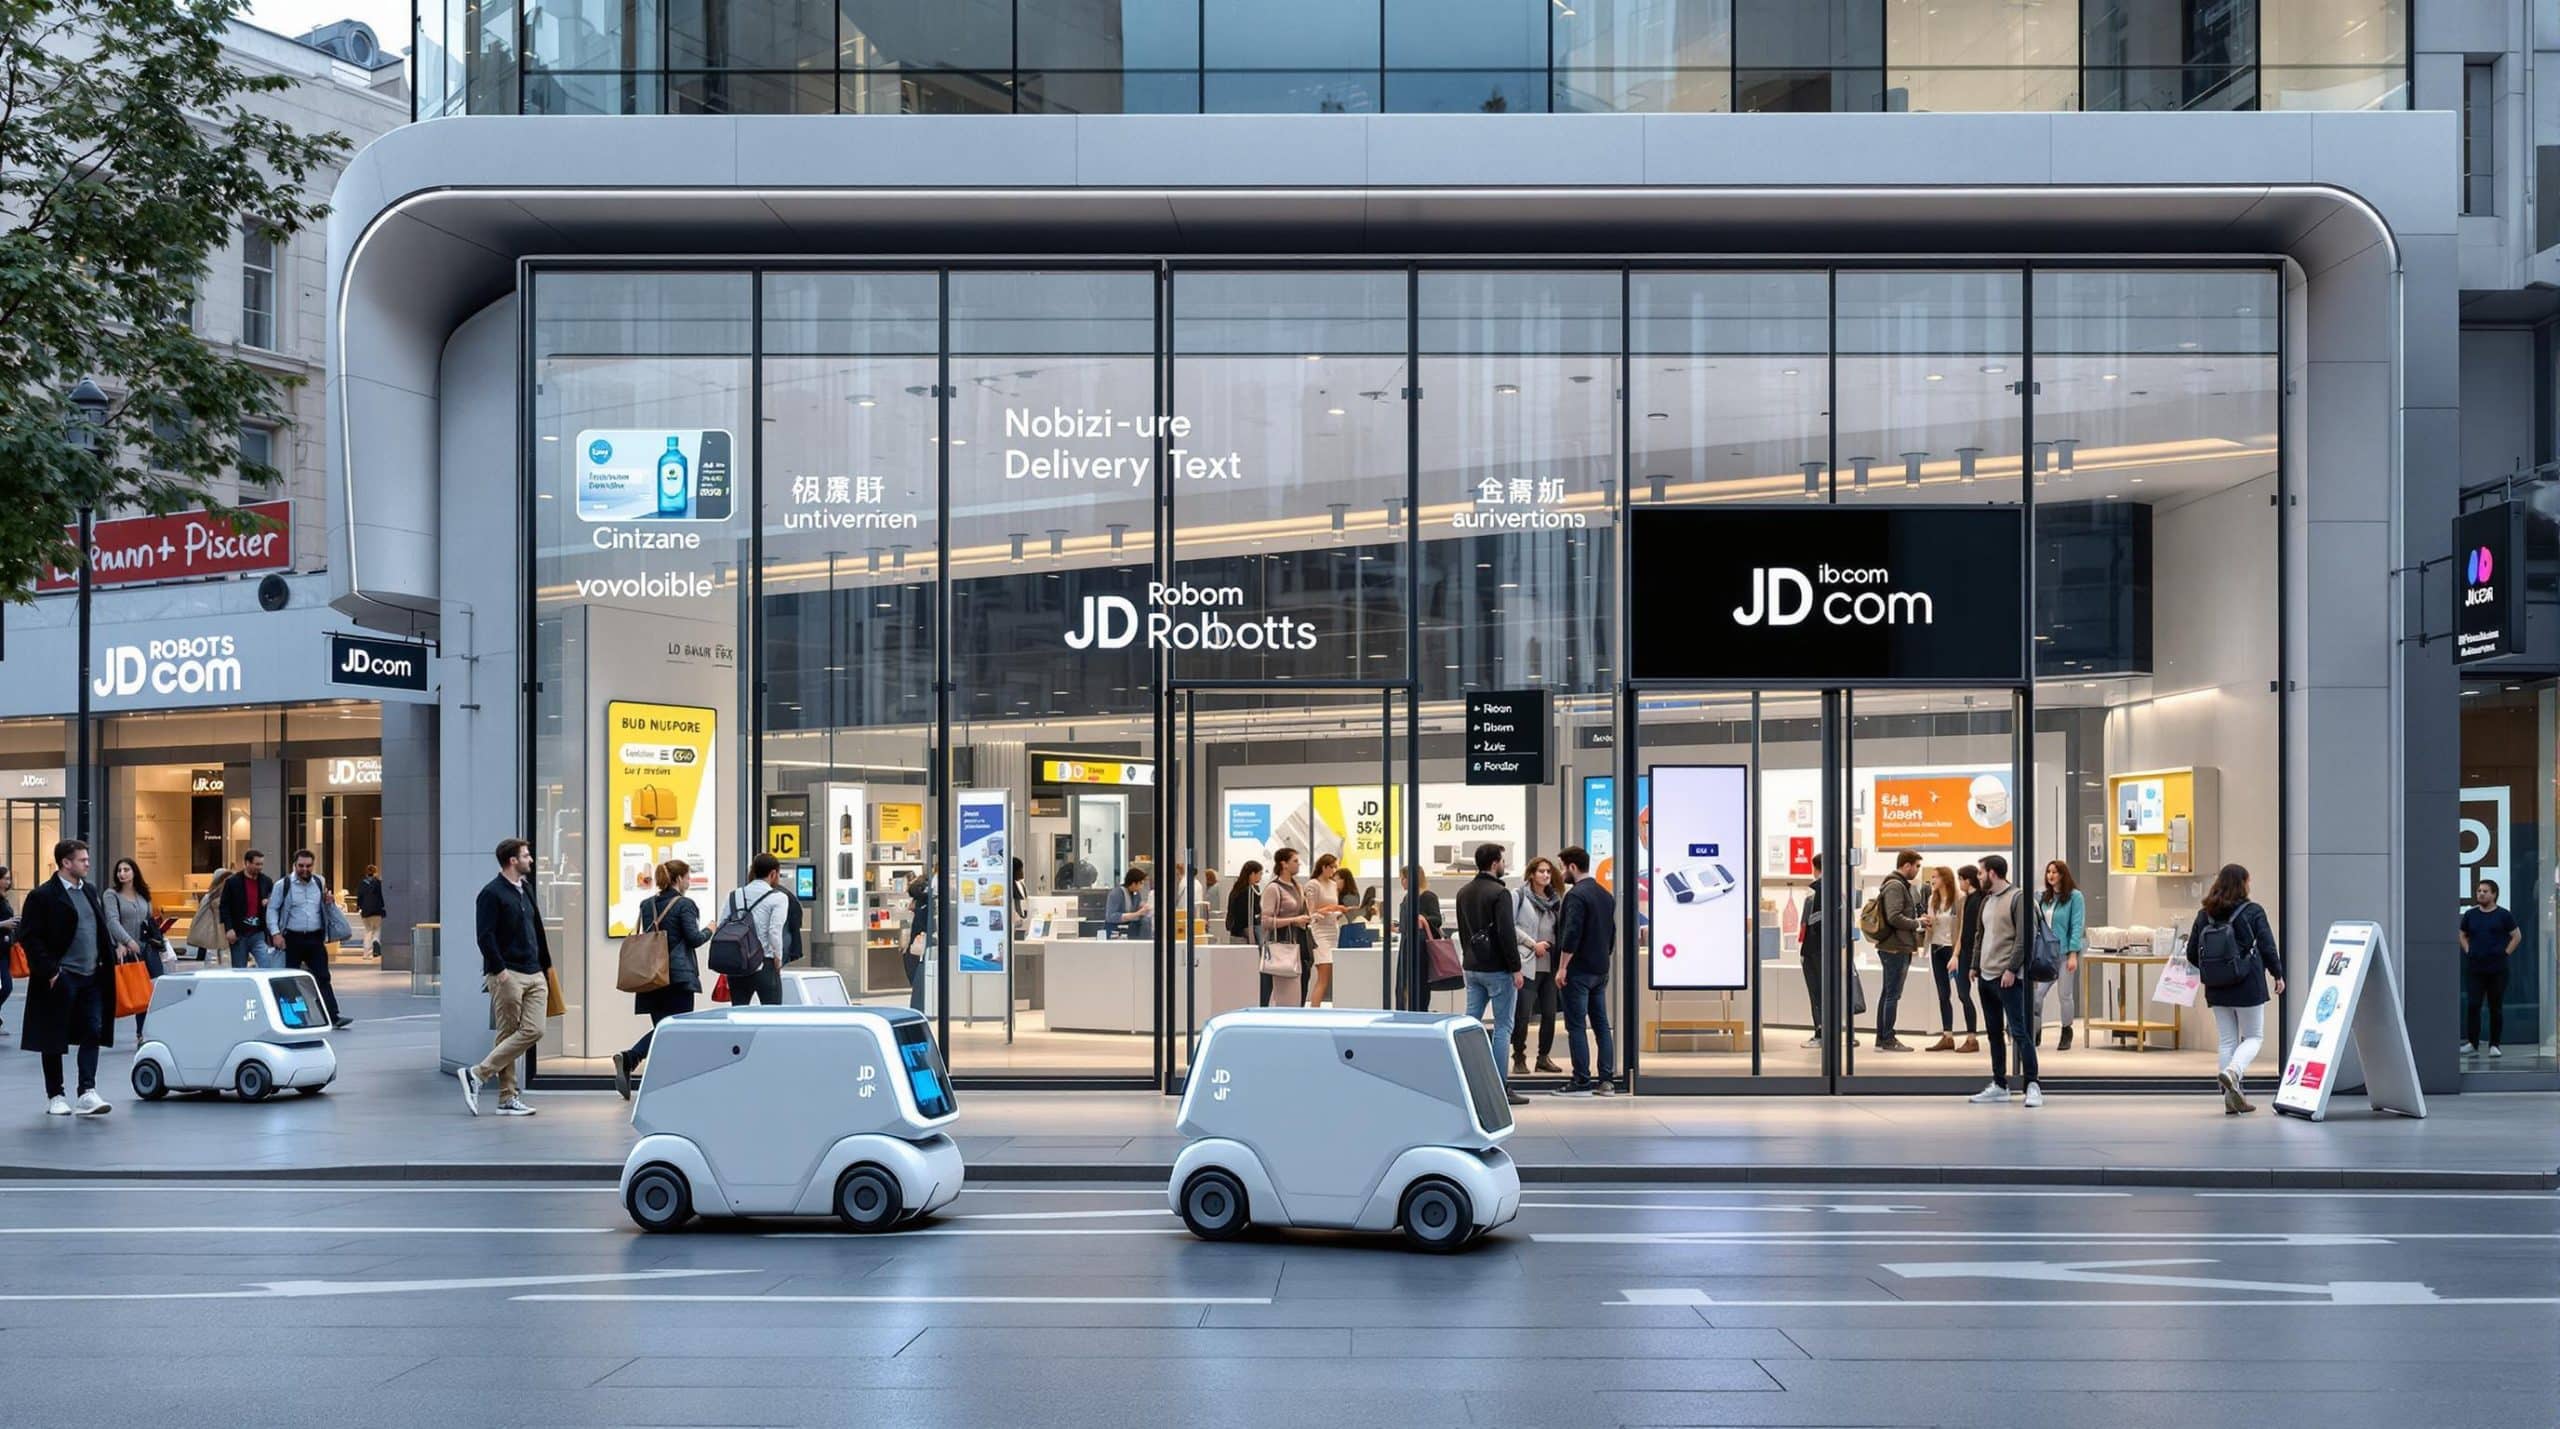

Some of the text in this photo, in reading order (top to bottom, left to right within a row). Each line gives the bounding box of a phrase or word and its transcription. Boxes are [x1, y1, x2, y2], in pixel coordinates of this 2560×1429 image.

[1005, 406, 1192, 438] Nobizi-ure
[1005, 448, 1242, 487] Delivery Text
[593, 526, 701, 549] Cintzane
[575, 571, 713, 598] vovoloible
[1148, 581, 1244, 606] Robom
[1732, 567, 1934, 626] JD com
[1063, 595, 1139, 650] JD
[150, 635, 235, 660] ROBOTS
[94, 645, 241, 697] JD com
[1357, 801, 1379, 816] JD
[856, 1064, 875, 1081] JD
[1211, 1069, 1231, 1084] JD
